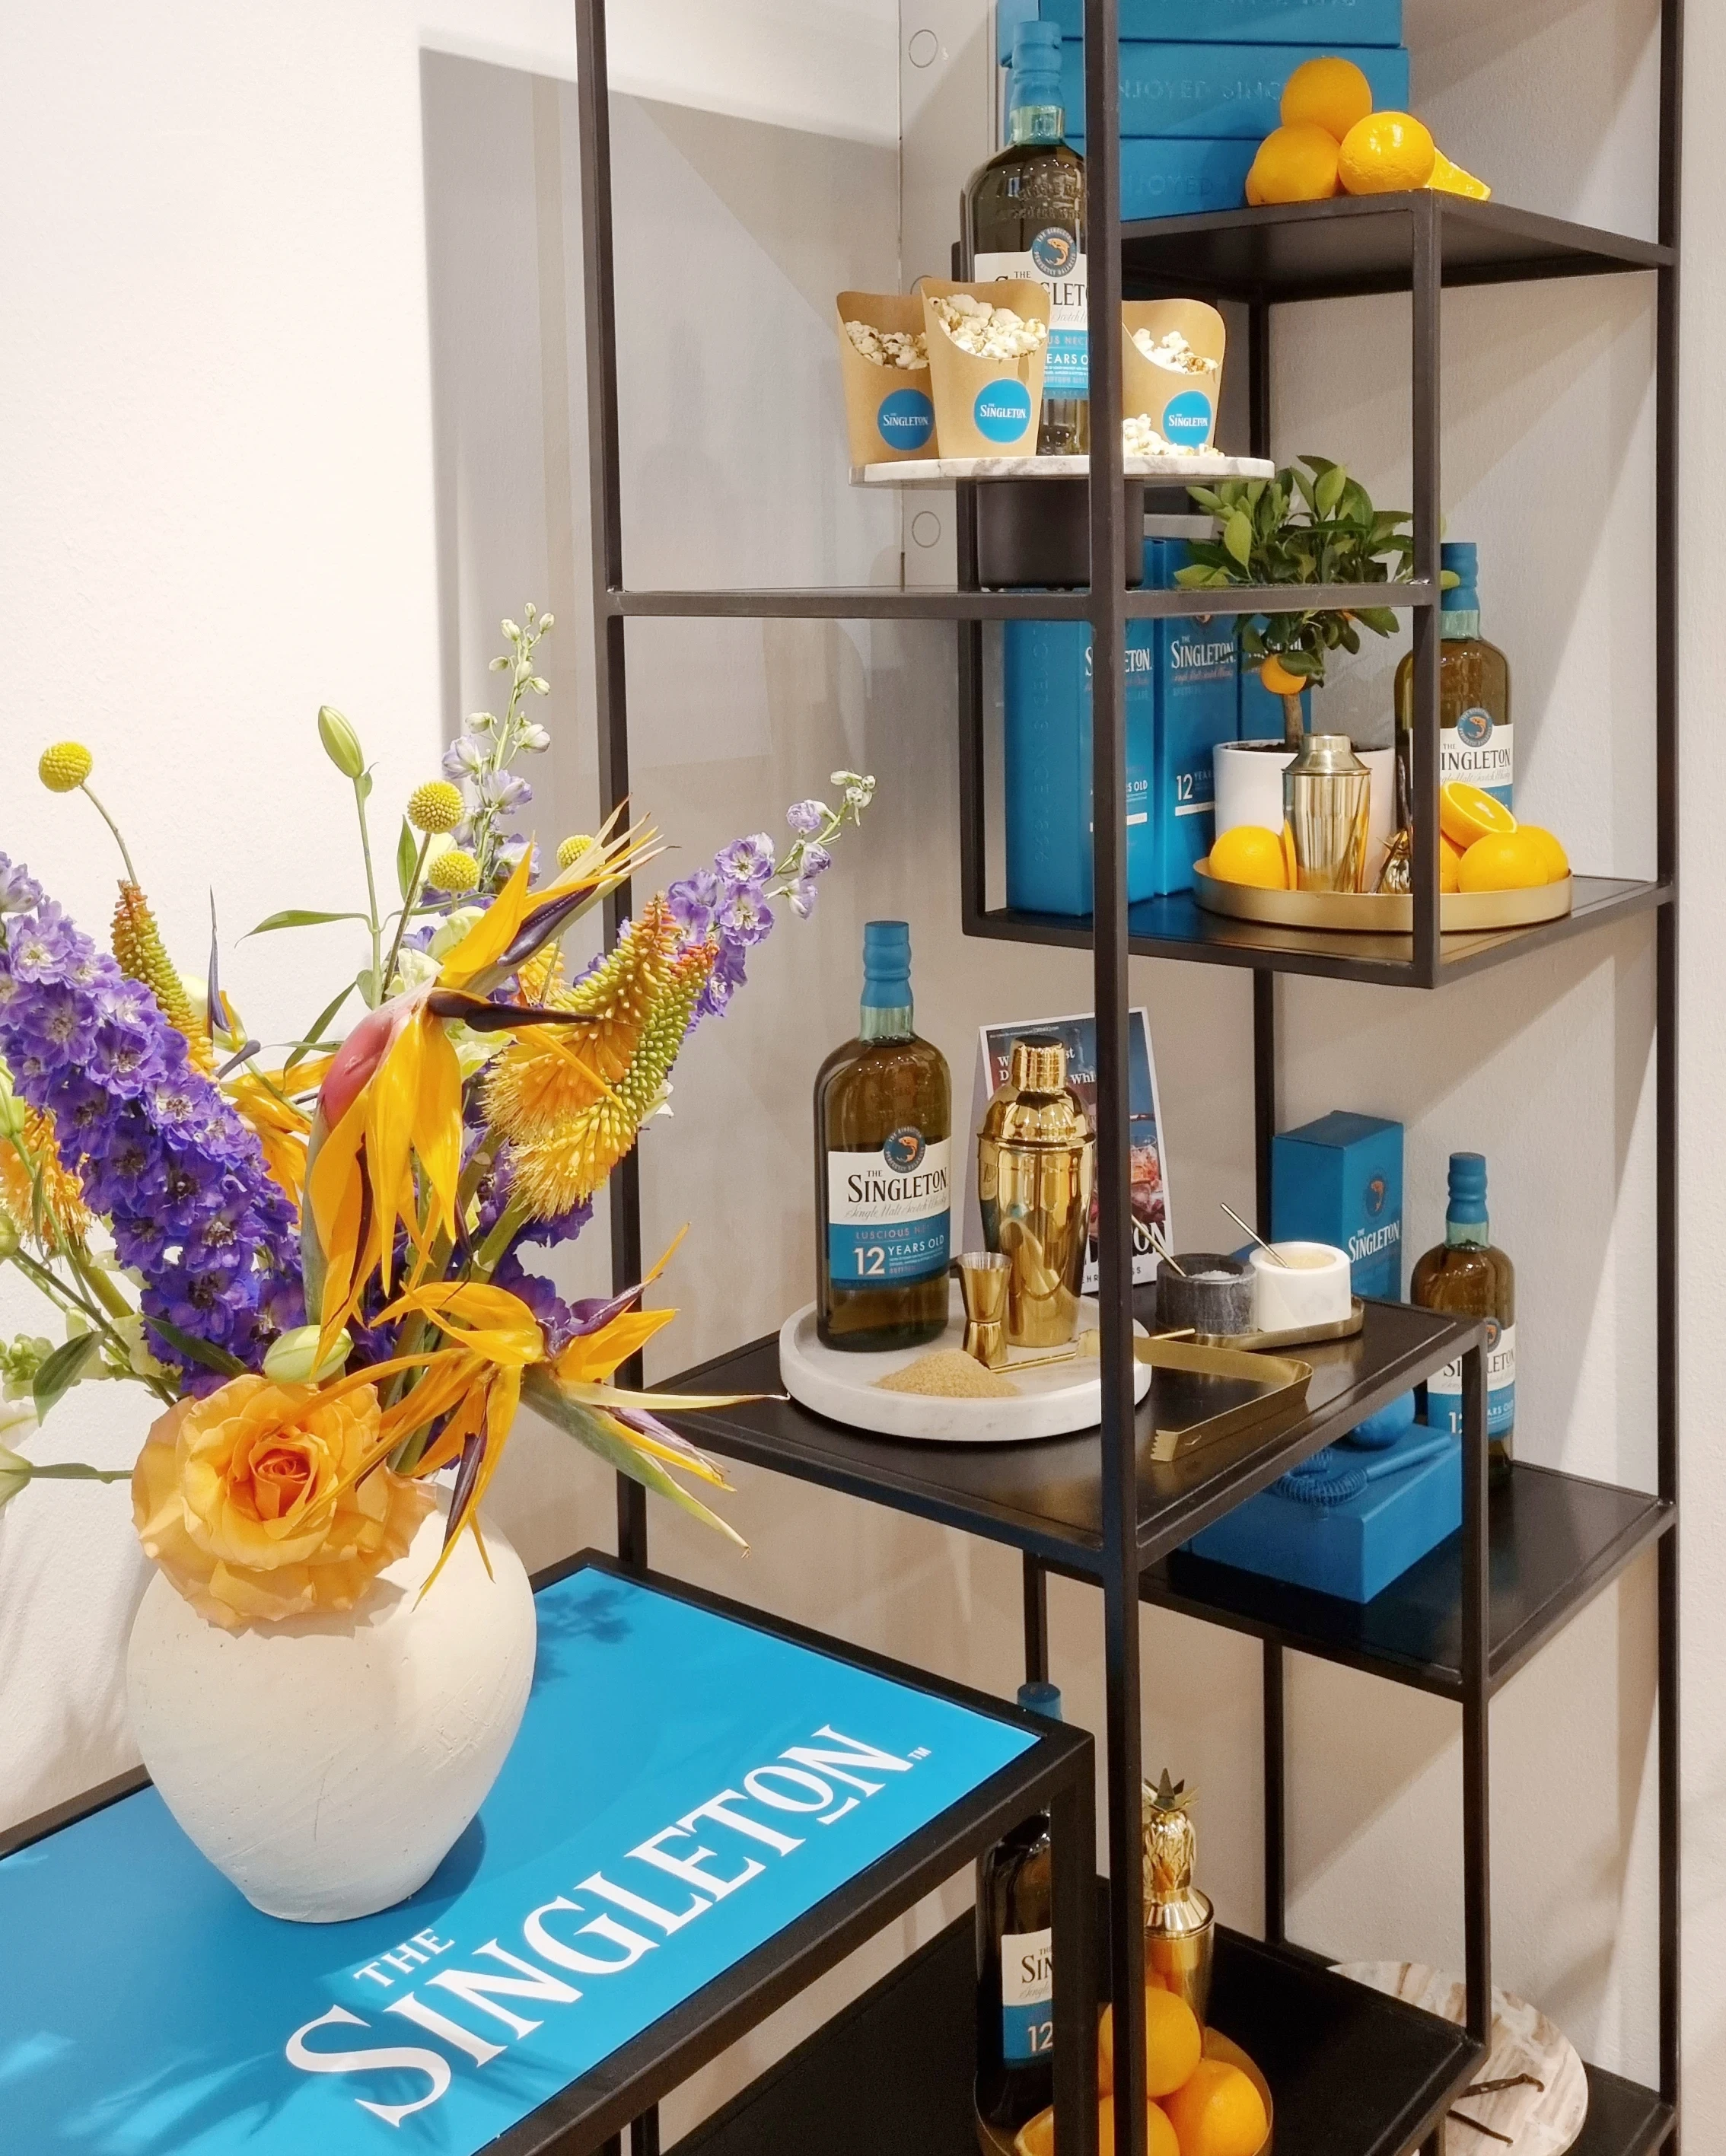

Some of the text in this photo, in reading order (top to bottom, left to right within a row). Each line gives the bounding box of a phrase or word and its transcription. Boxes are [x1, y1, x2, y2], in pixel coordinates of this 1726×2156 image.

[1119, 80, 1281, 101] NJOYED SINC
[1046, 353, 1078, 365] EARS
[883, 414, 929, 427] SINGLETON
[980, 405, 1027, 419] SINGLETON
[1168, 414, 1209, 427] SINGLETON
[1084, 646, 1152, 677] SETON
[1171, 640, 1235, 670] SINGLETON
[1441, 748, 1511, 771] INGLETON
[1134, 780, 1148, 791] OLD
[1176, 773, 1193, 801] 12
[848, 1167, 947, 1203] SINGLETON
[856, 1228, 909, 1240] LUSCIOUS
[1348, 1220, 1400, 1263] SINGLETON
[854, 1246, 885, 1275] 12
[888, 1240, 925, 1256] YEARS
[928, 1234, 944, 1249] OLD
[285, 1724, 913, 2129] SINGLETON
[354, 1927, 456, 1988] THE
[1027, 2021, 1053, 2052] 12
